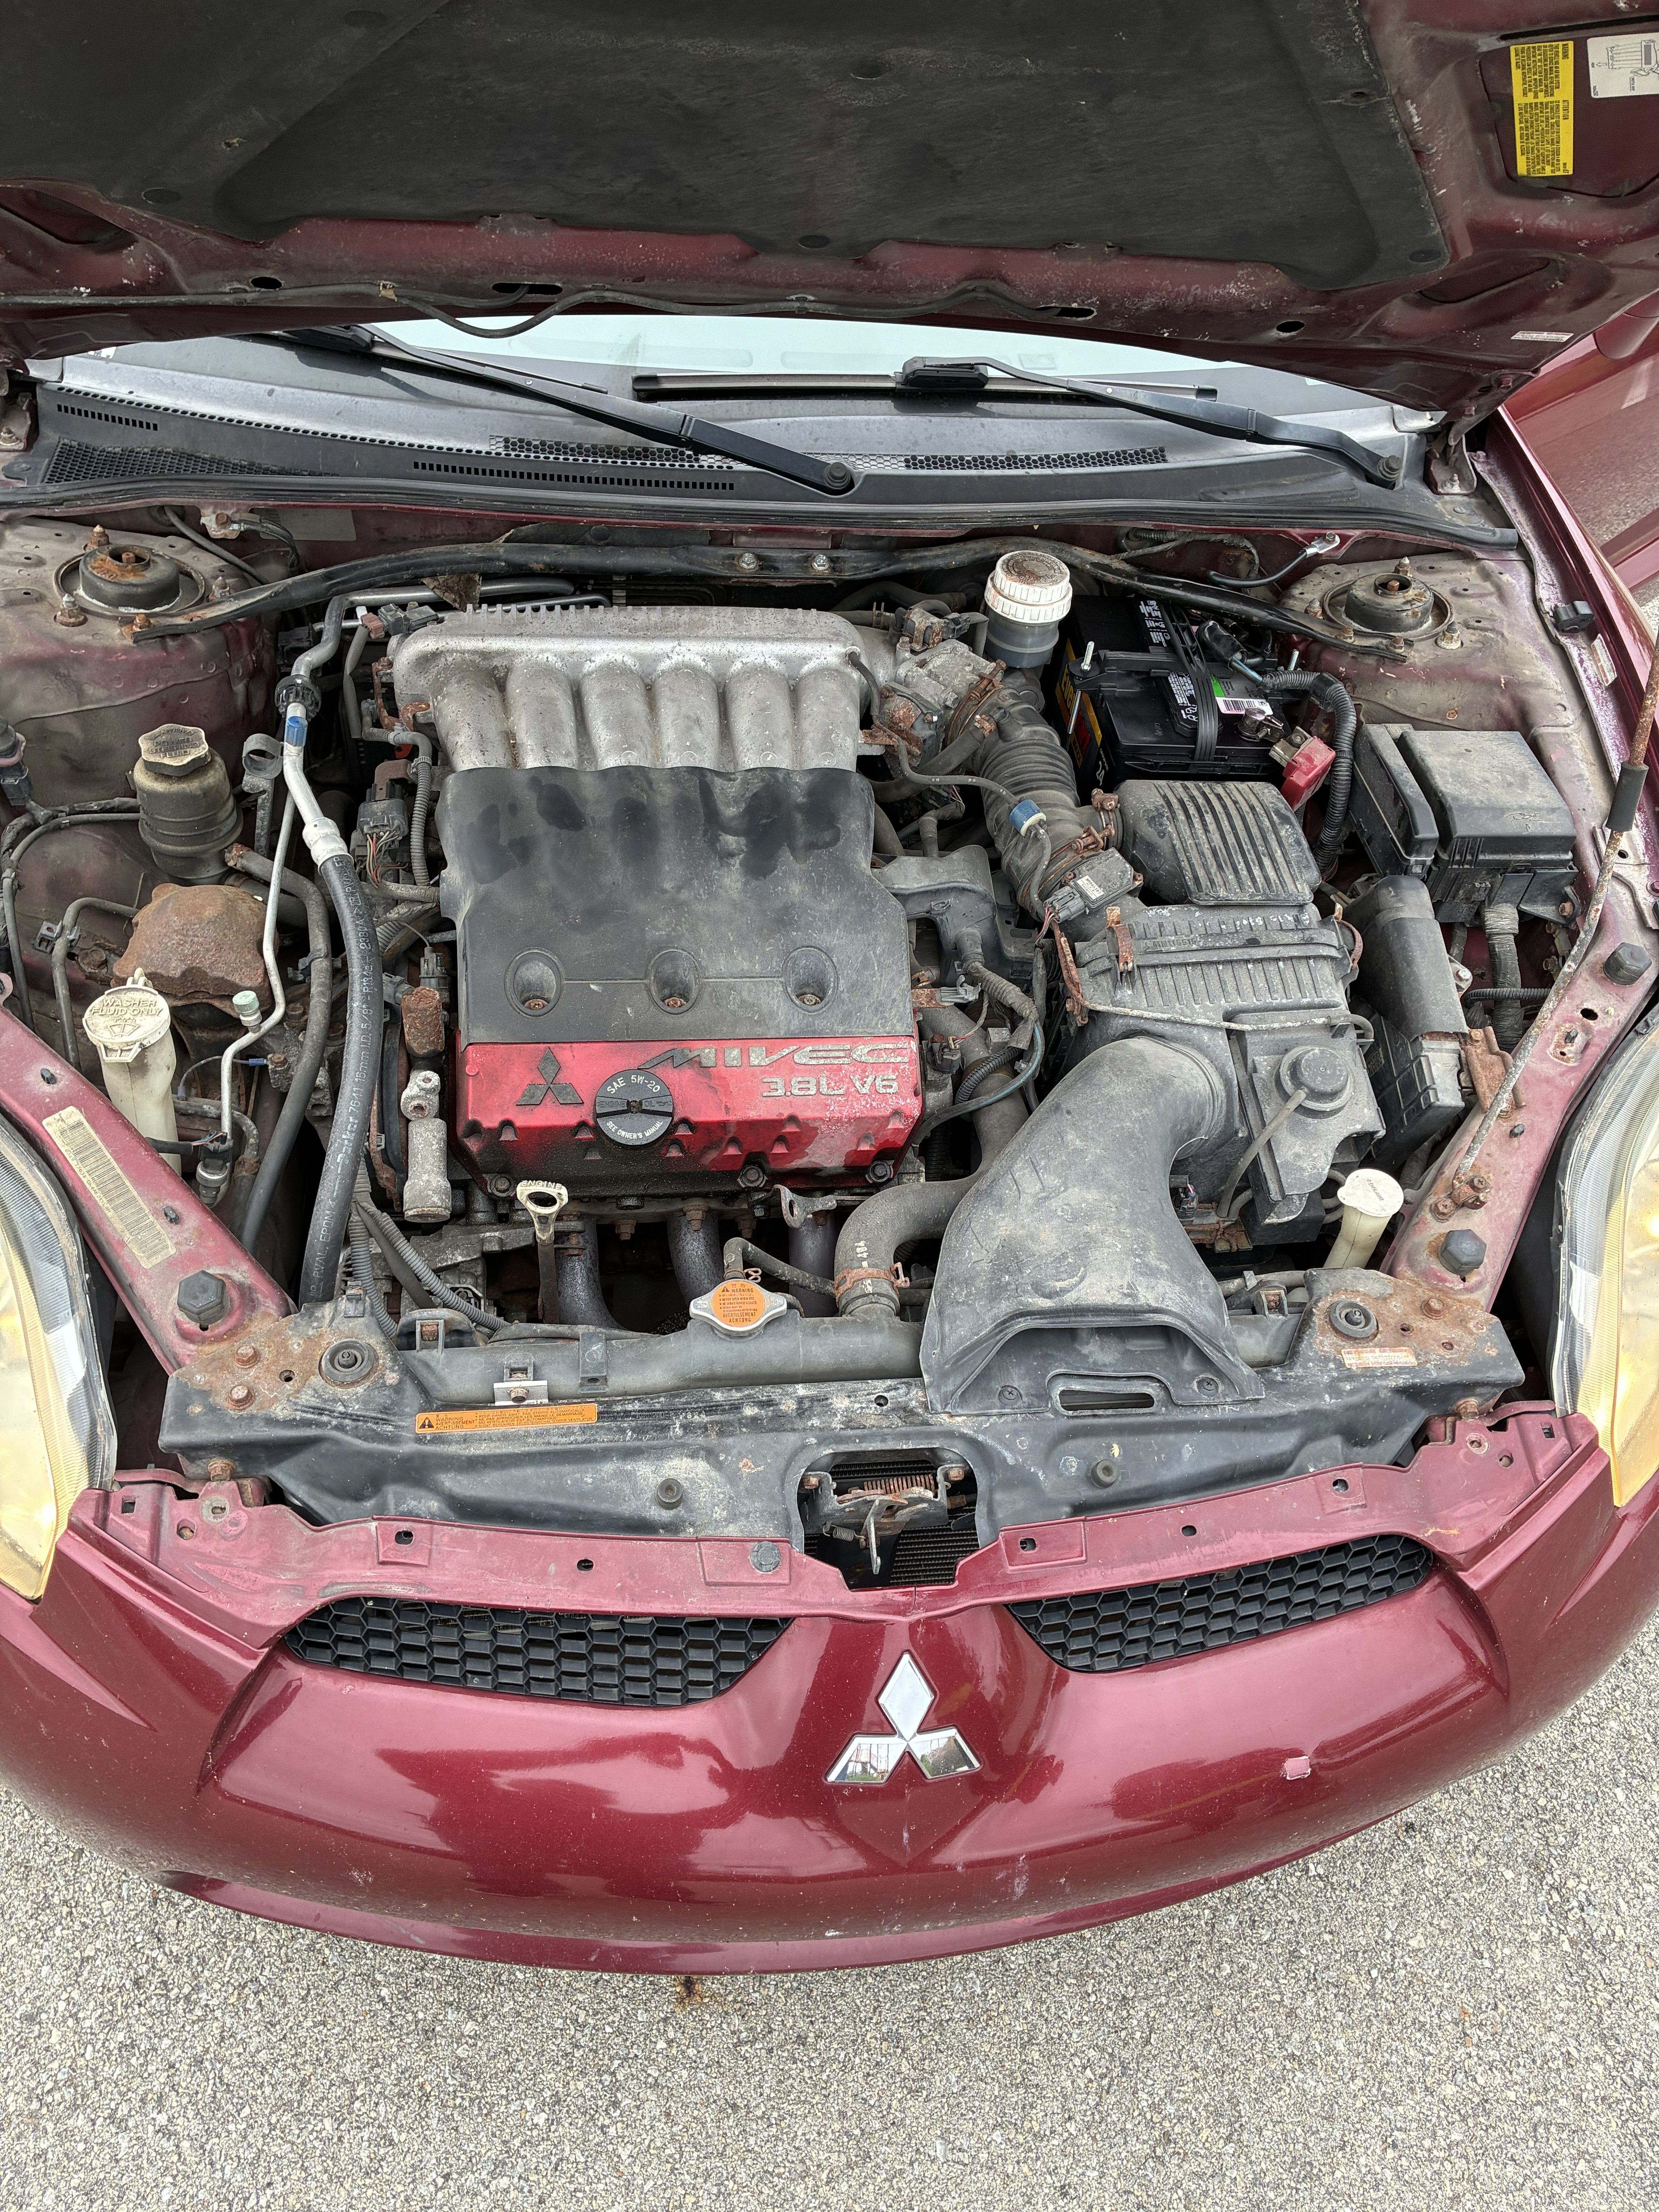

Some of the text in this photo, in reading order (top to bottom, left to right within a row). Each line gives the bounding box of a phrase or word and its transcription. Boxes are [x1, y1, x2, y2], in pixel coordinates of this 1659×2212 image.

[149, 742, 200, 754] STEERING
[155, 737, 193, 747] POWER
[161, 749, 190, 759] FLUID
[1096, 761, 1105, 787] 24
[103, 998, 157, 1007] WASHER
[91, 1007, 163, 1016] FLUID ONLY
[637, 1043, 909, 1069] MIVEC
[355, 1051, 369, 1082] 16mm
[607, 1077, 626, 1094] SAE
[762, 1075, 898, 1097] 3.8L V6
[606, 1121, 663, 1139] SEE OWNER'S MANUAL
[522, 1180, 562, 1190] ENGINE
